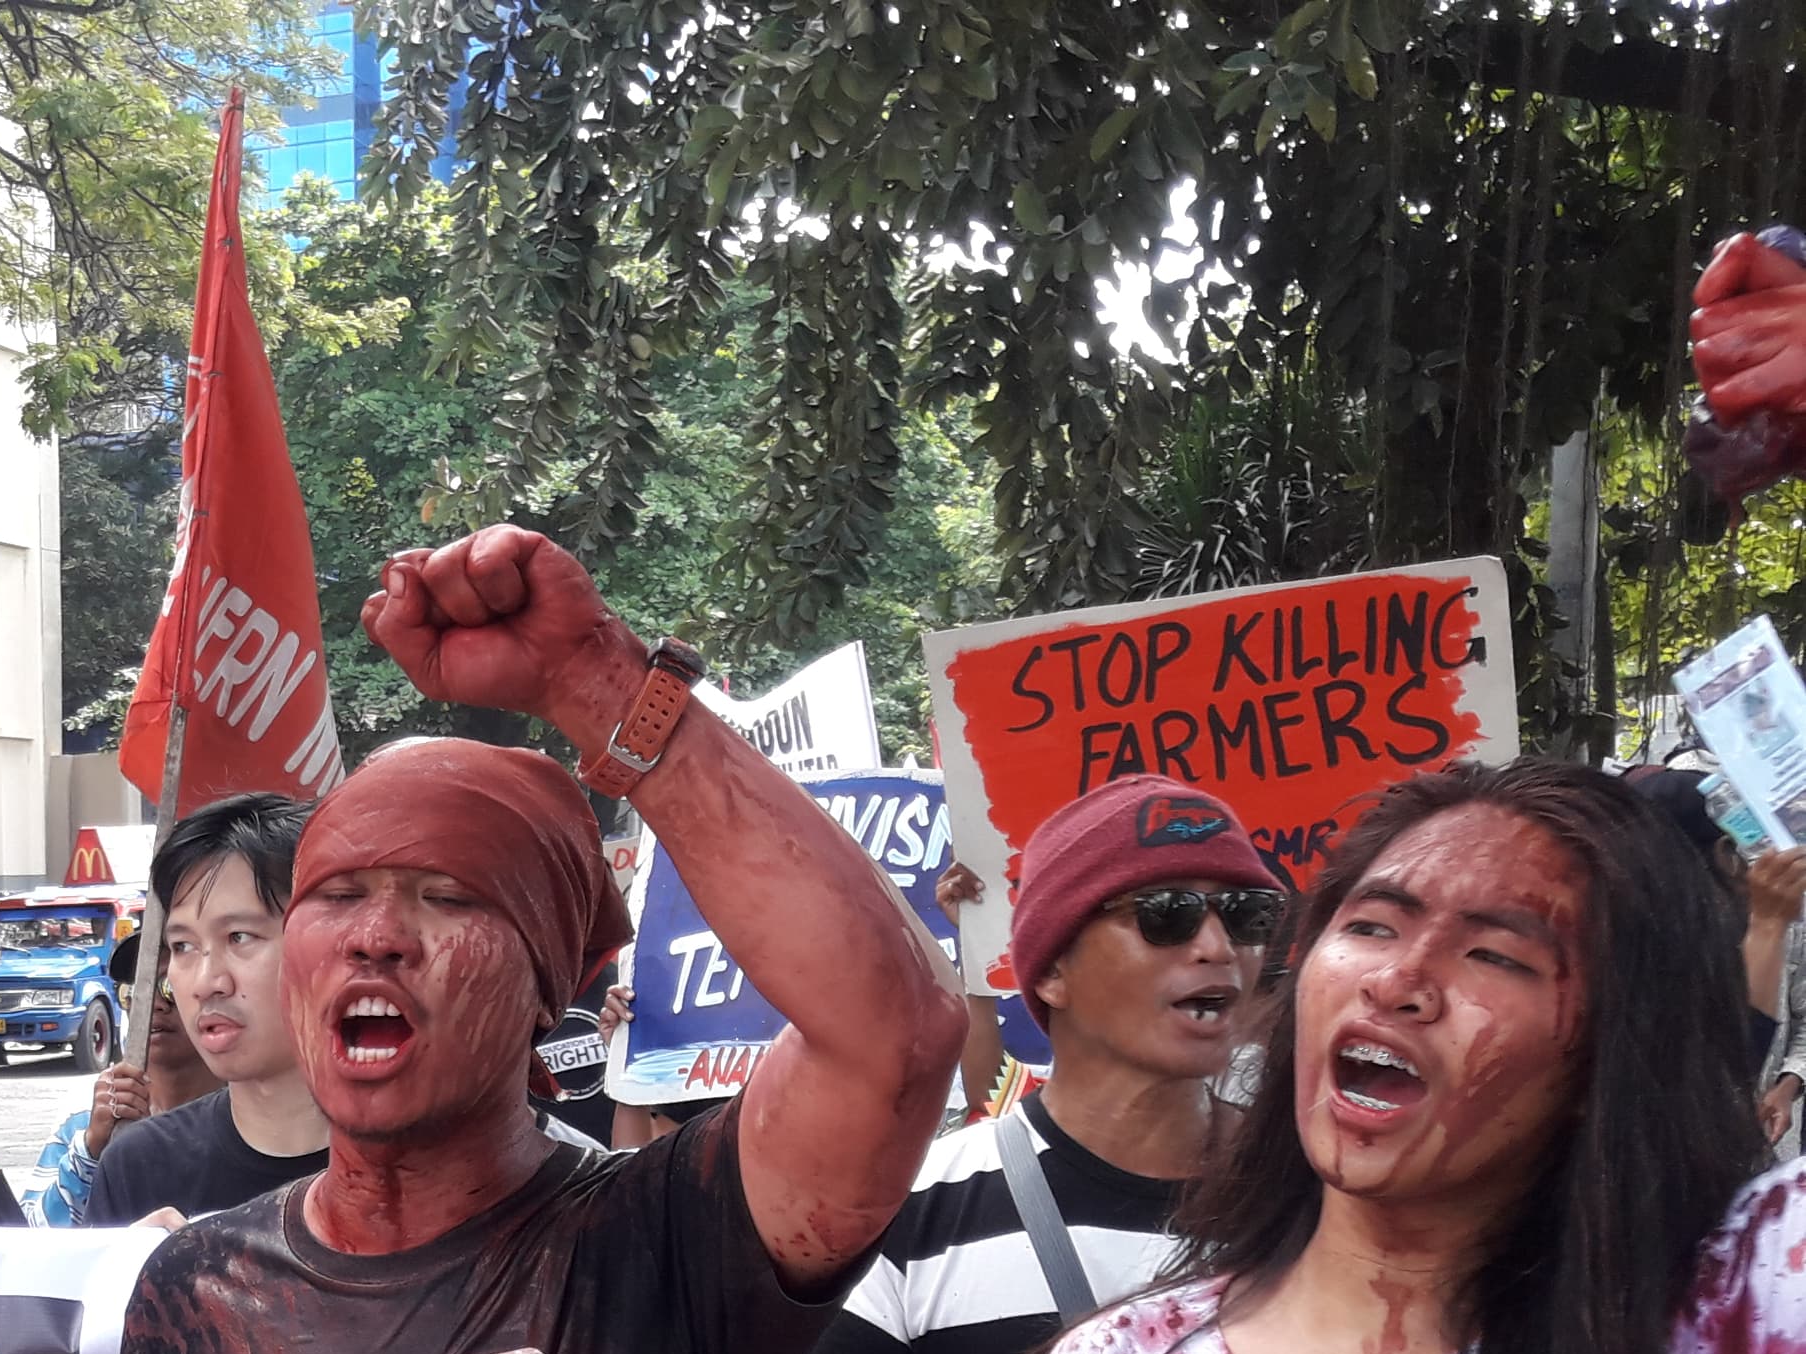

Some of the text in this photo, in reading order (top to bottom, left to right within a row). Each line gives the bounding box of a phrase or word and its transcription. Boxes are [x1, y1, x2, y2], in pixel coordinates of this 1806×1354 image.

[1005, 586, 1488, 733] STOP KILLING
[1077, 672, 1451, 799] FARMERS
[541, 1042, 609, 1071] RIGHT!
